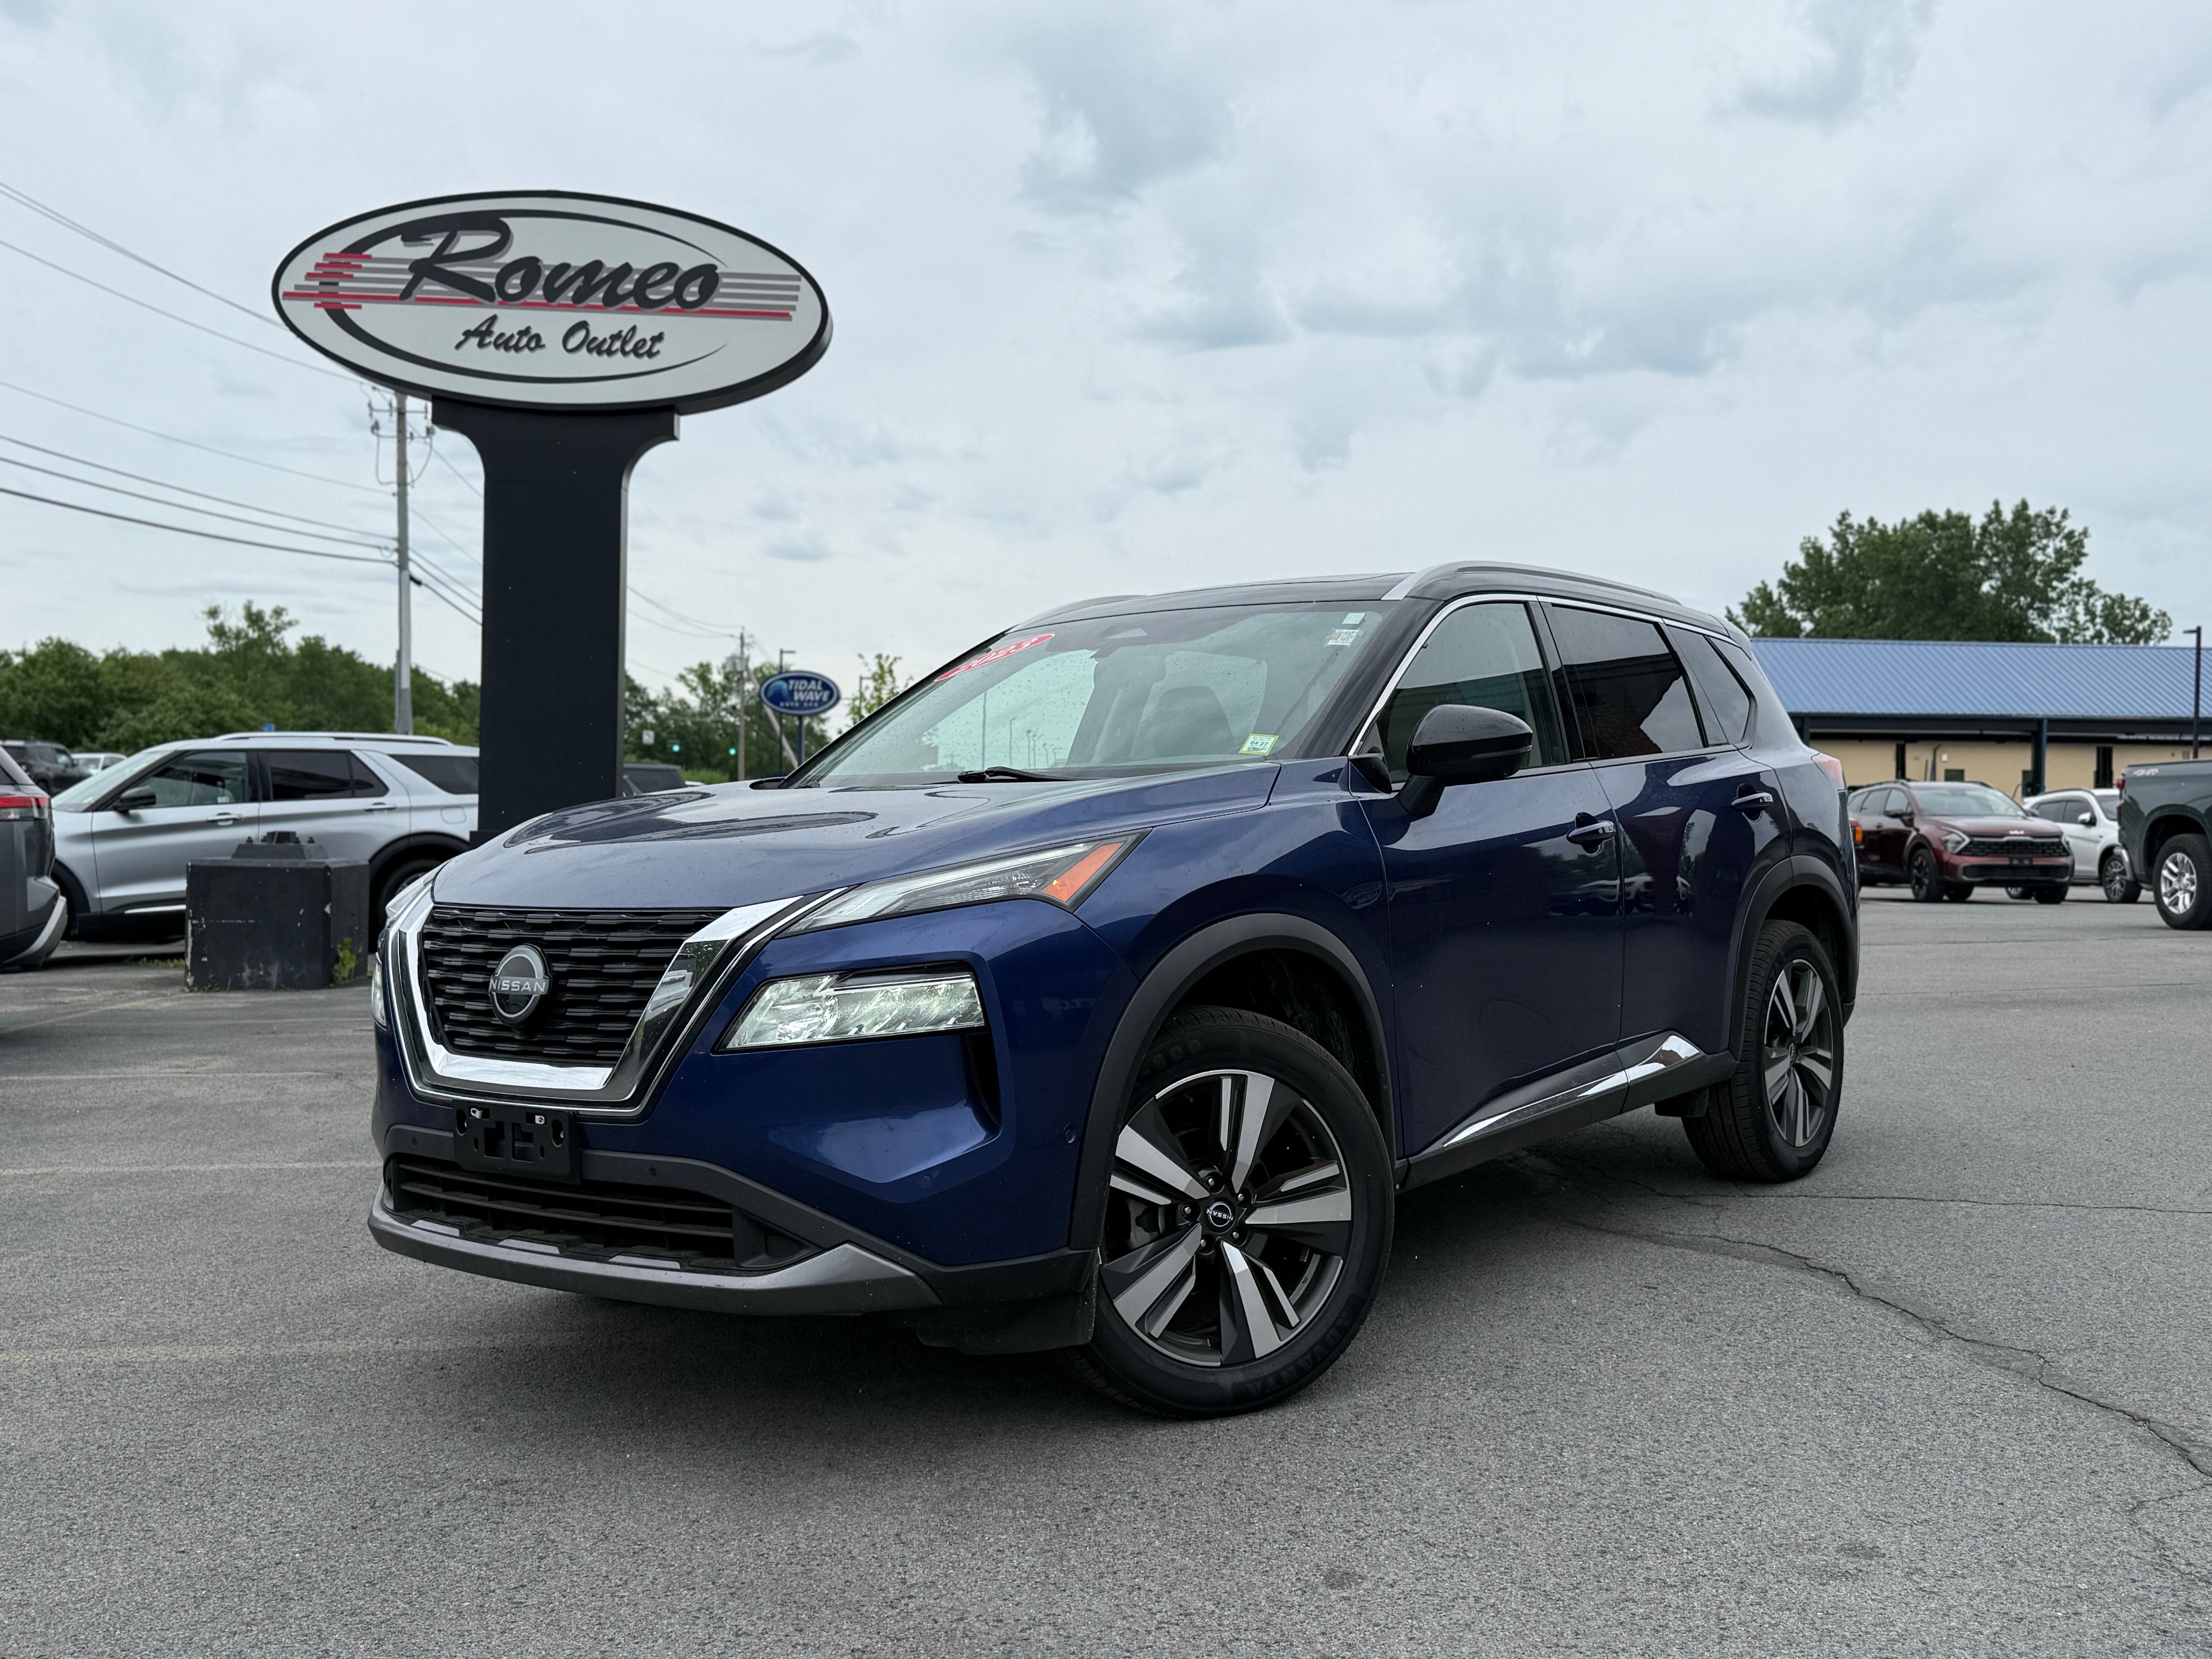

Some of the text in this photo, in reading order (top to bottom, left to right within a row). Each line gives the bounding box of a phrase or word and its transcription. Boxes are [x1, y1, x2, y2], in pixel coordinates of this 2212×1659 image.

[399, 215, 721, 310] Romeo
[455, 313, 664, 358] Auto Outlet
[788, 680, 823, 690] TIDAL
[793, 690, 830, 701] WAVE
[489, 979, 546, 992] NISSAN
[1207, 1208, 1233, 1221] NISSAN
